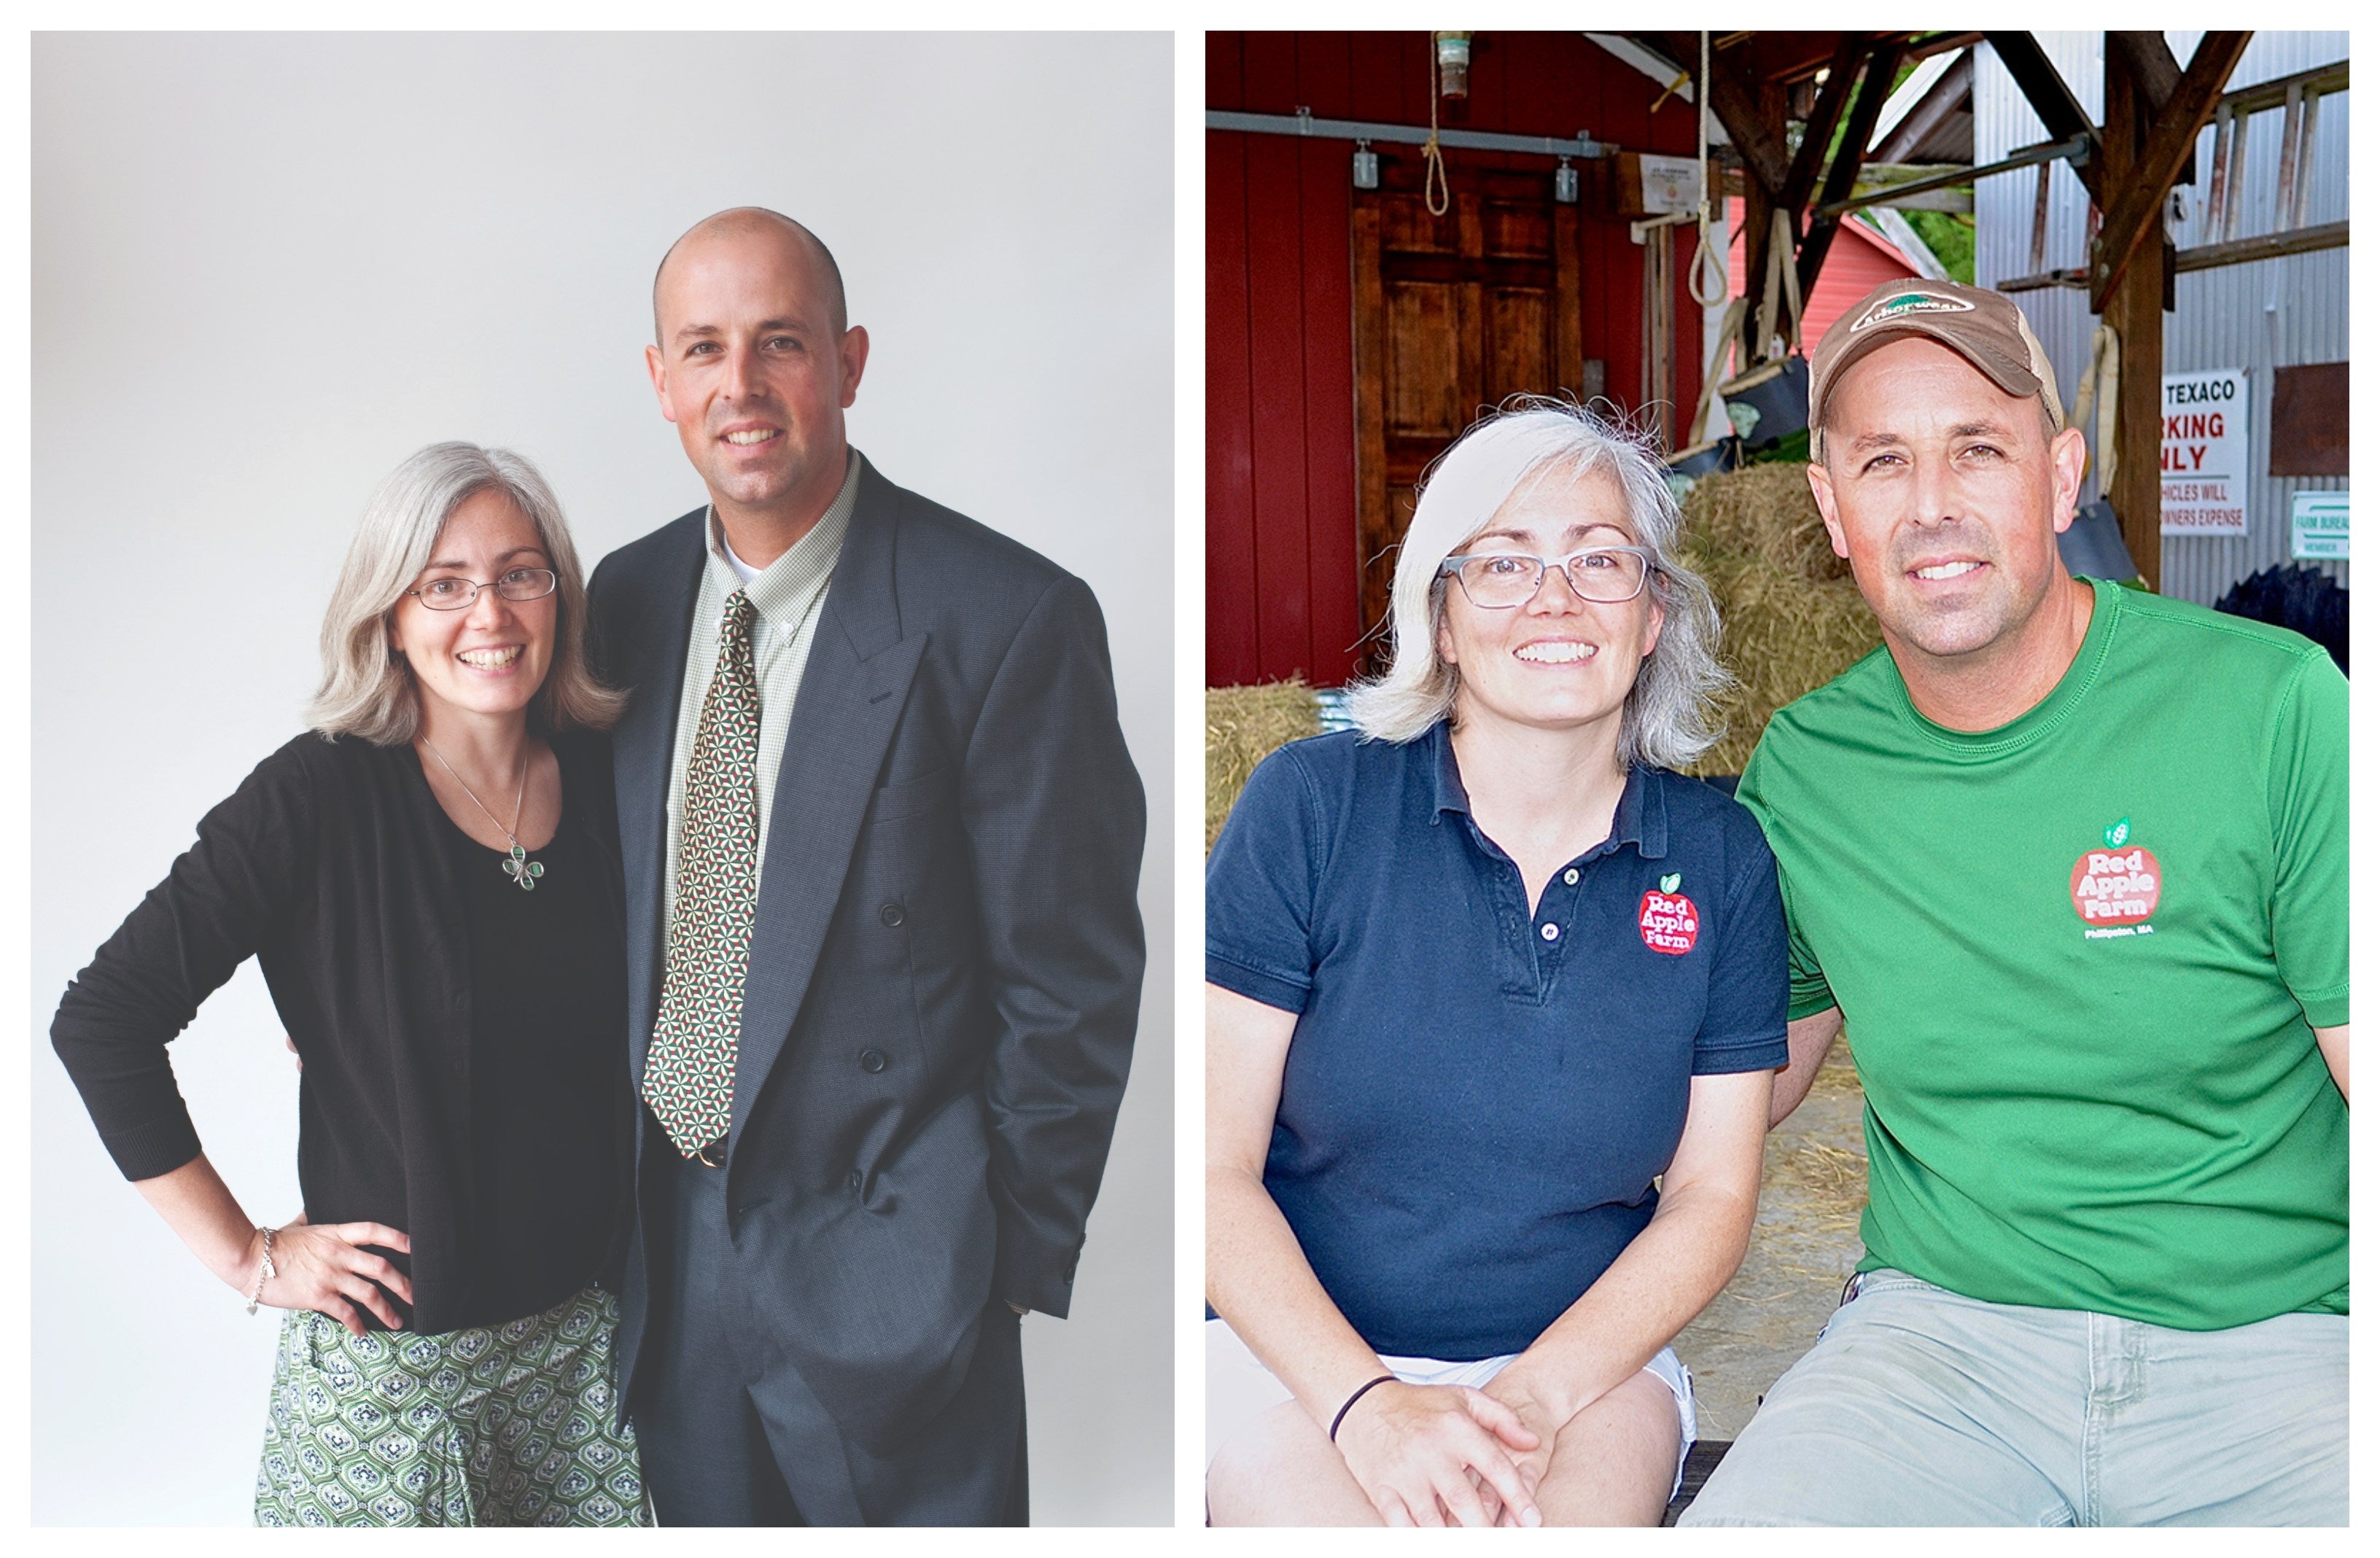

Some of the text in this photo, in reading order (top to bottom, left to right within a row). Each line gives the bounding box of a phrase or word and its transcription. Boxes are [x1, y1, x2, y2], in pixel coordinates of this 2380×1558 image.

[2166, 379, 2235, 404] TEXACO
[2201, 483, 2228, 502] WILL
[2160, 508, 2243, 526] WNERS EXPENSE
[2295, 515, 2317, 529] FARM
[2088, 850, 2142, 875] Red
[2077, 872, 2155, 900] Apple
[1647, 895, 1688, 916] Red
[2084, 899, 2147, 919] Farm
[1641, 910, 1695, 934] Apple
[1646, 930, 1689, 948] Farm
